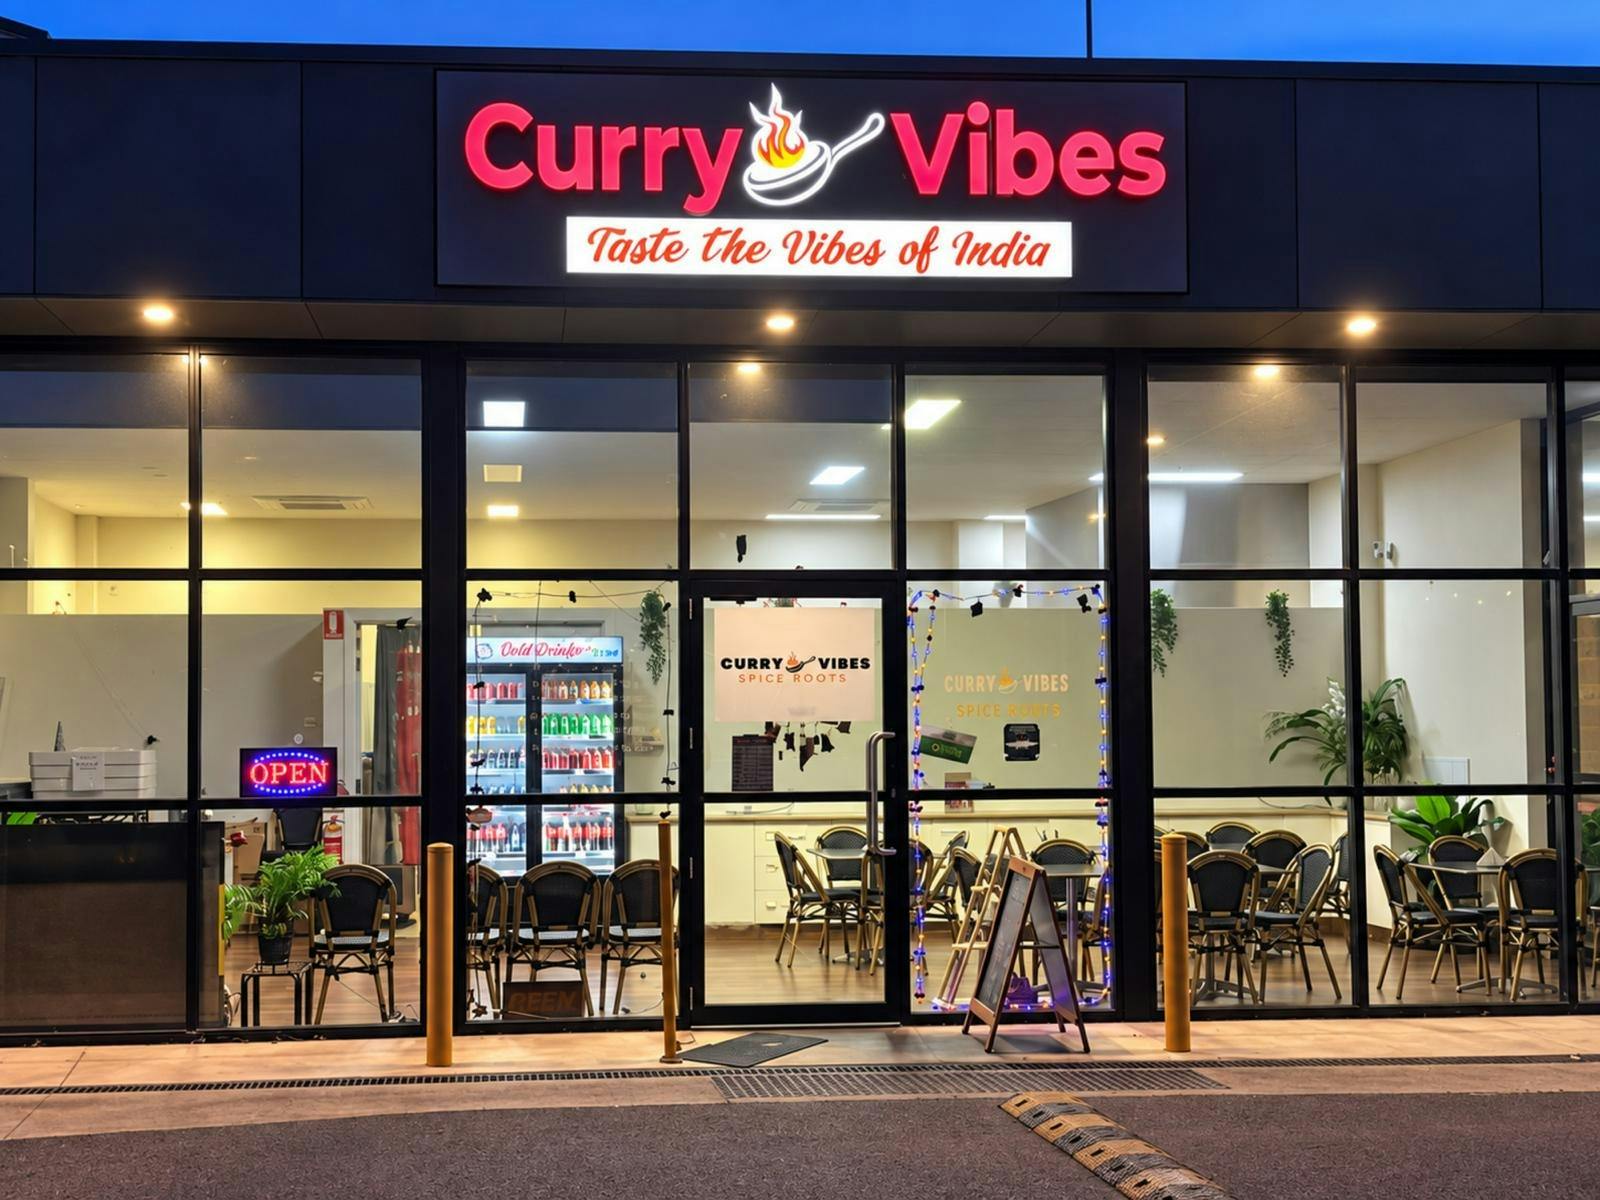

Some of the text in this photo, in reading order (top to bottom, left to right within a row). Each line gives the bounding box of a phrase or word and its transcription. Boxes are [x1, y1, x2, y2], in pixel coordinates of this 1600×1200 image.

[464, 101, 1167, 215] Curry Vibes
[587, 225, 1052, 274] Taste the Vibes of India
[720, 657, 871, 670] CURRY VIBES
[738, 673, 847, 683] SPICE ROOTS
[944, 673, 1069, 693] CURRY VIBES
[956, 703, 1000, 718] SPICE
[250, 762, 329, 784] OPEN
